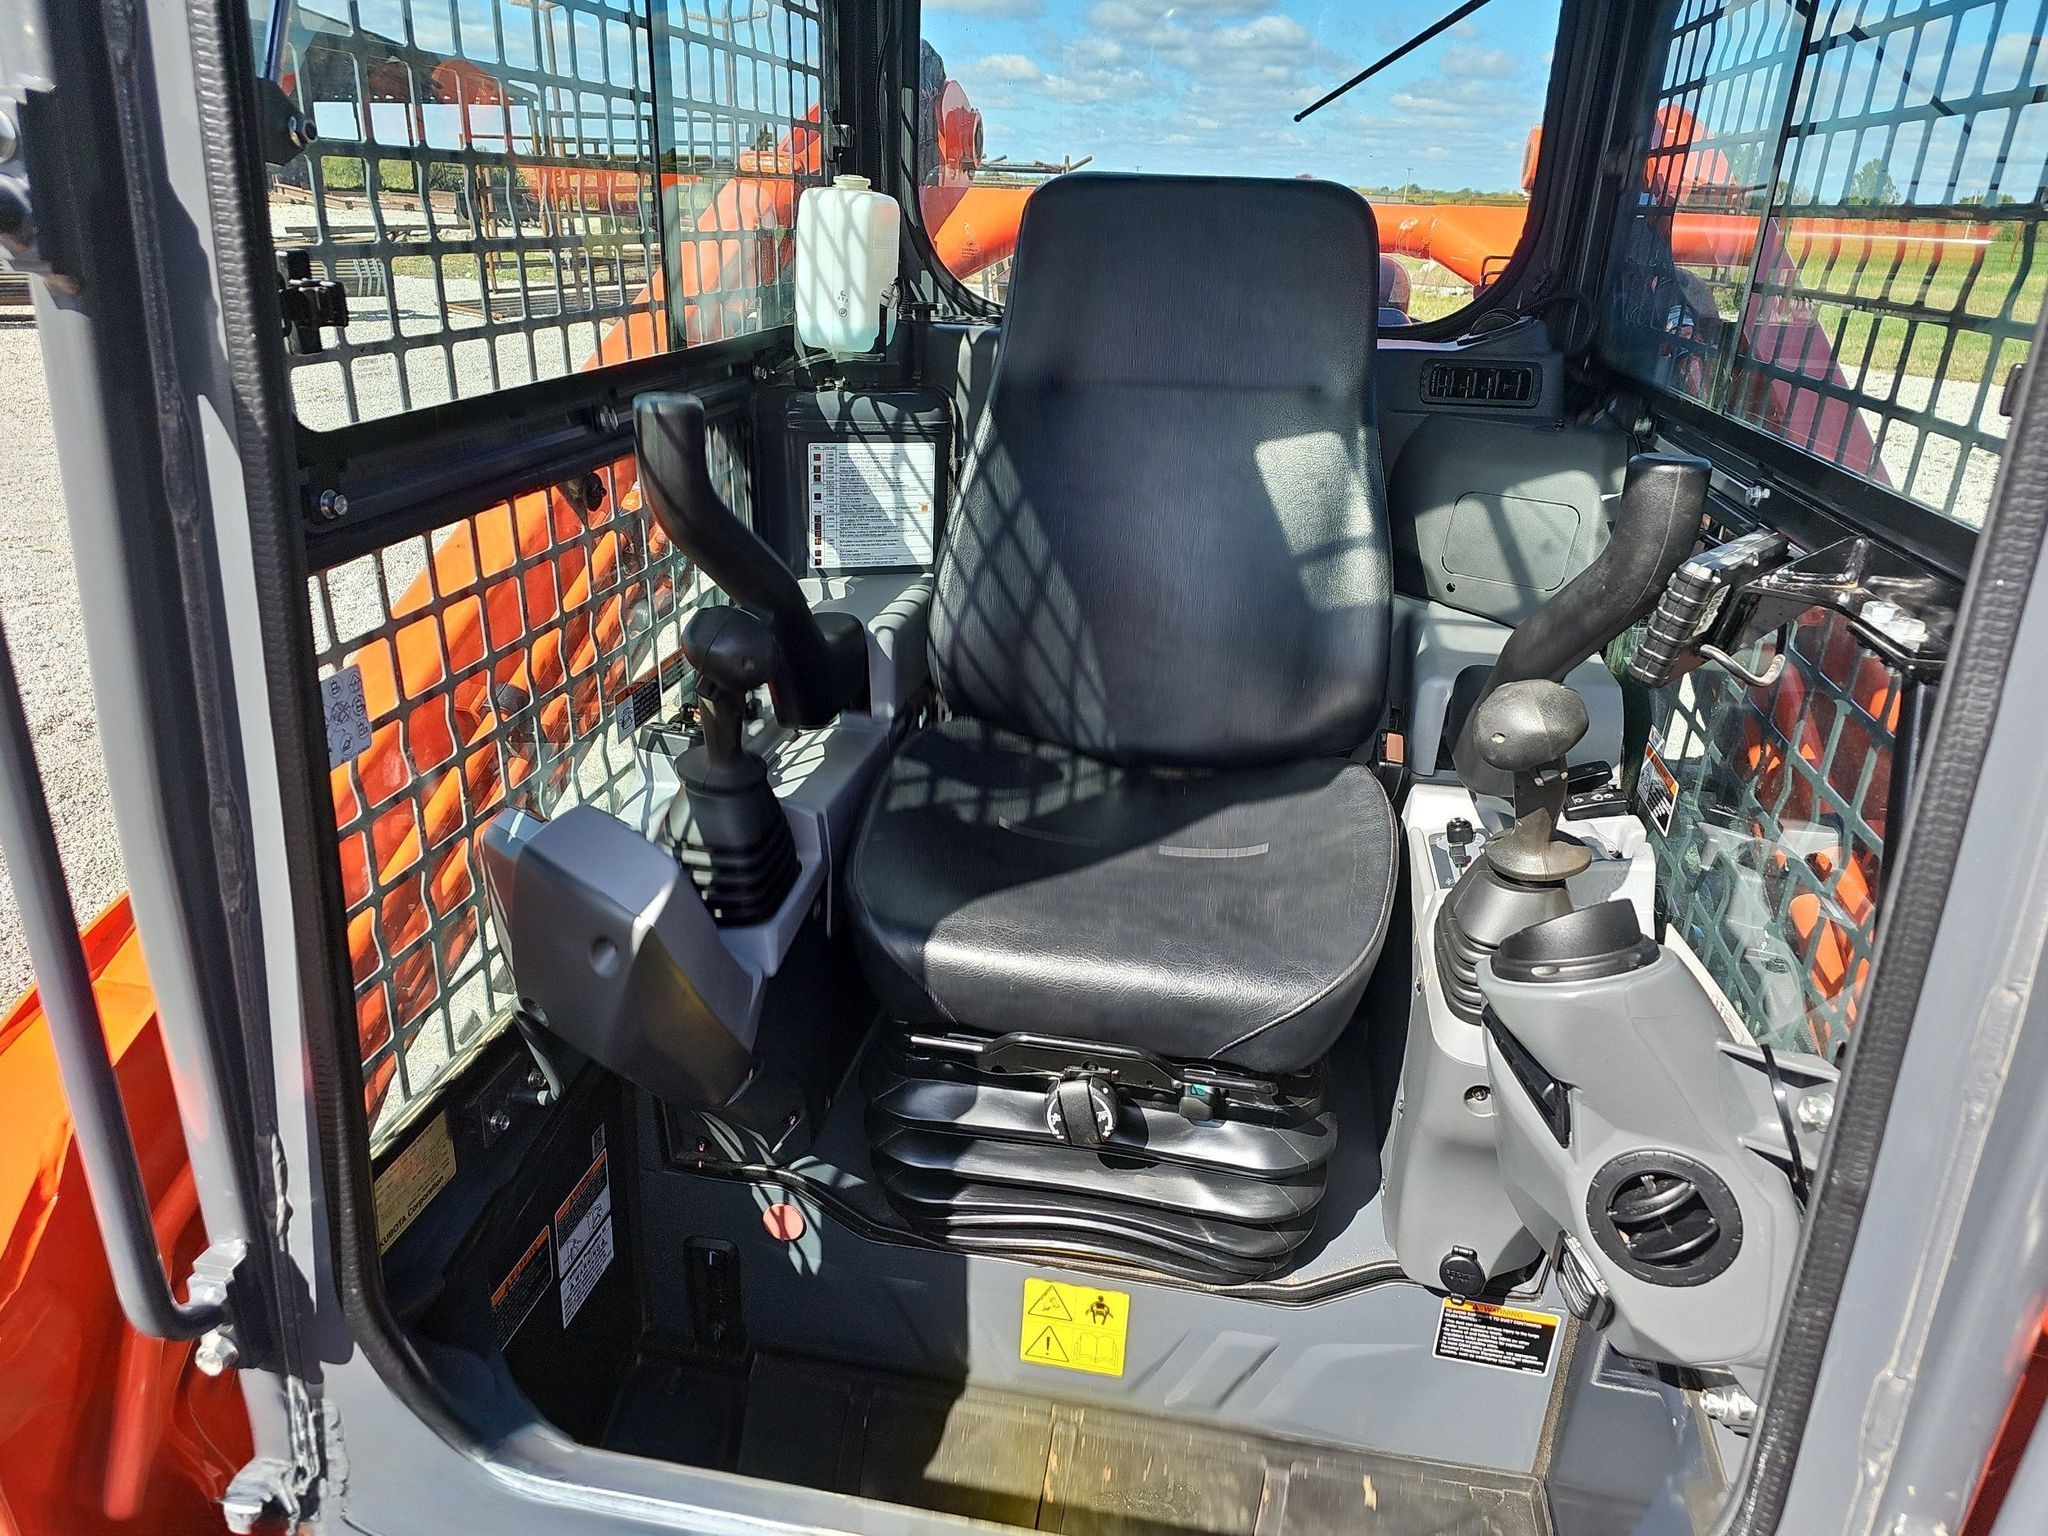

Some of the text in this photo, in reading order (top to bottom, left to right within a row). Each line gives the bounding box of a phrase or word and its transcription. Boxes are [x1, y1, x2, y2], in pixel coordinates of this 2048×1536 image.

[379, 1215, 406, 1246] KUBOTA
[407, 1175, 443, 1217] Corporation
[1484, 1306, 1523, 1318] WARNING
